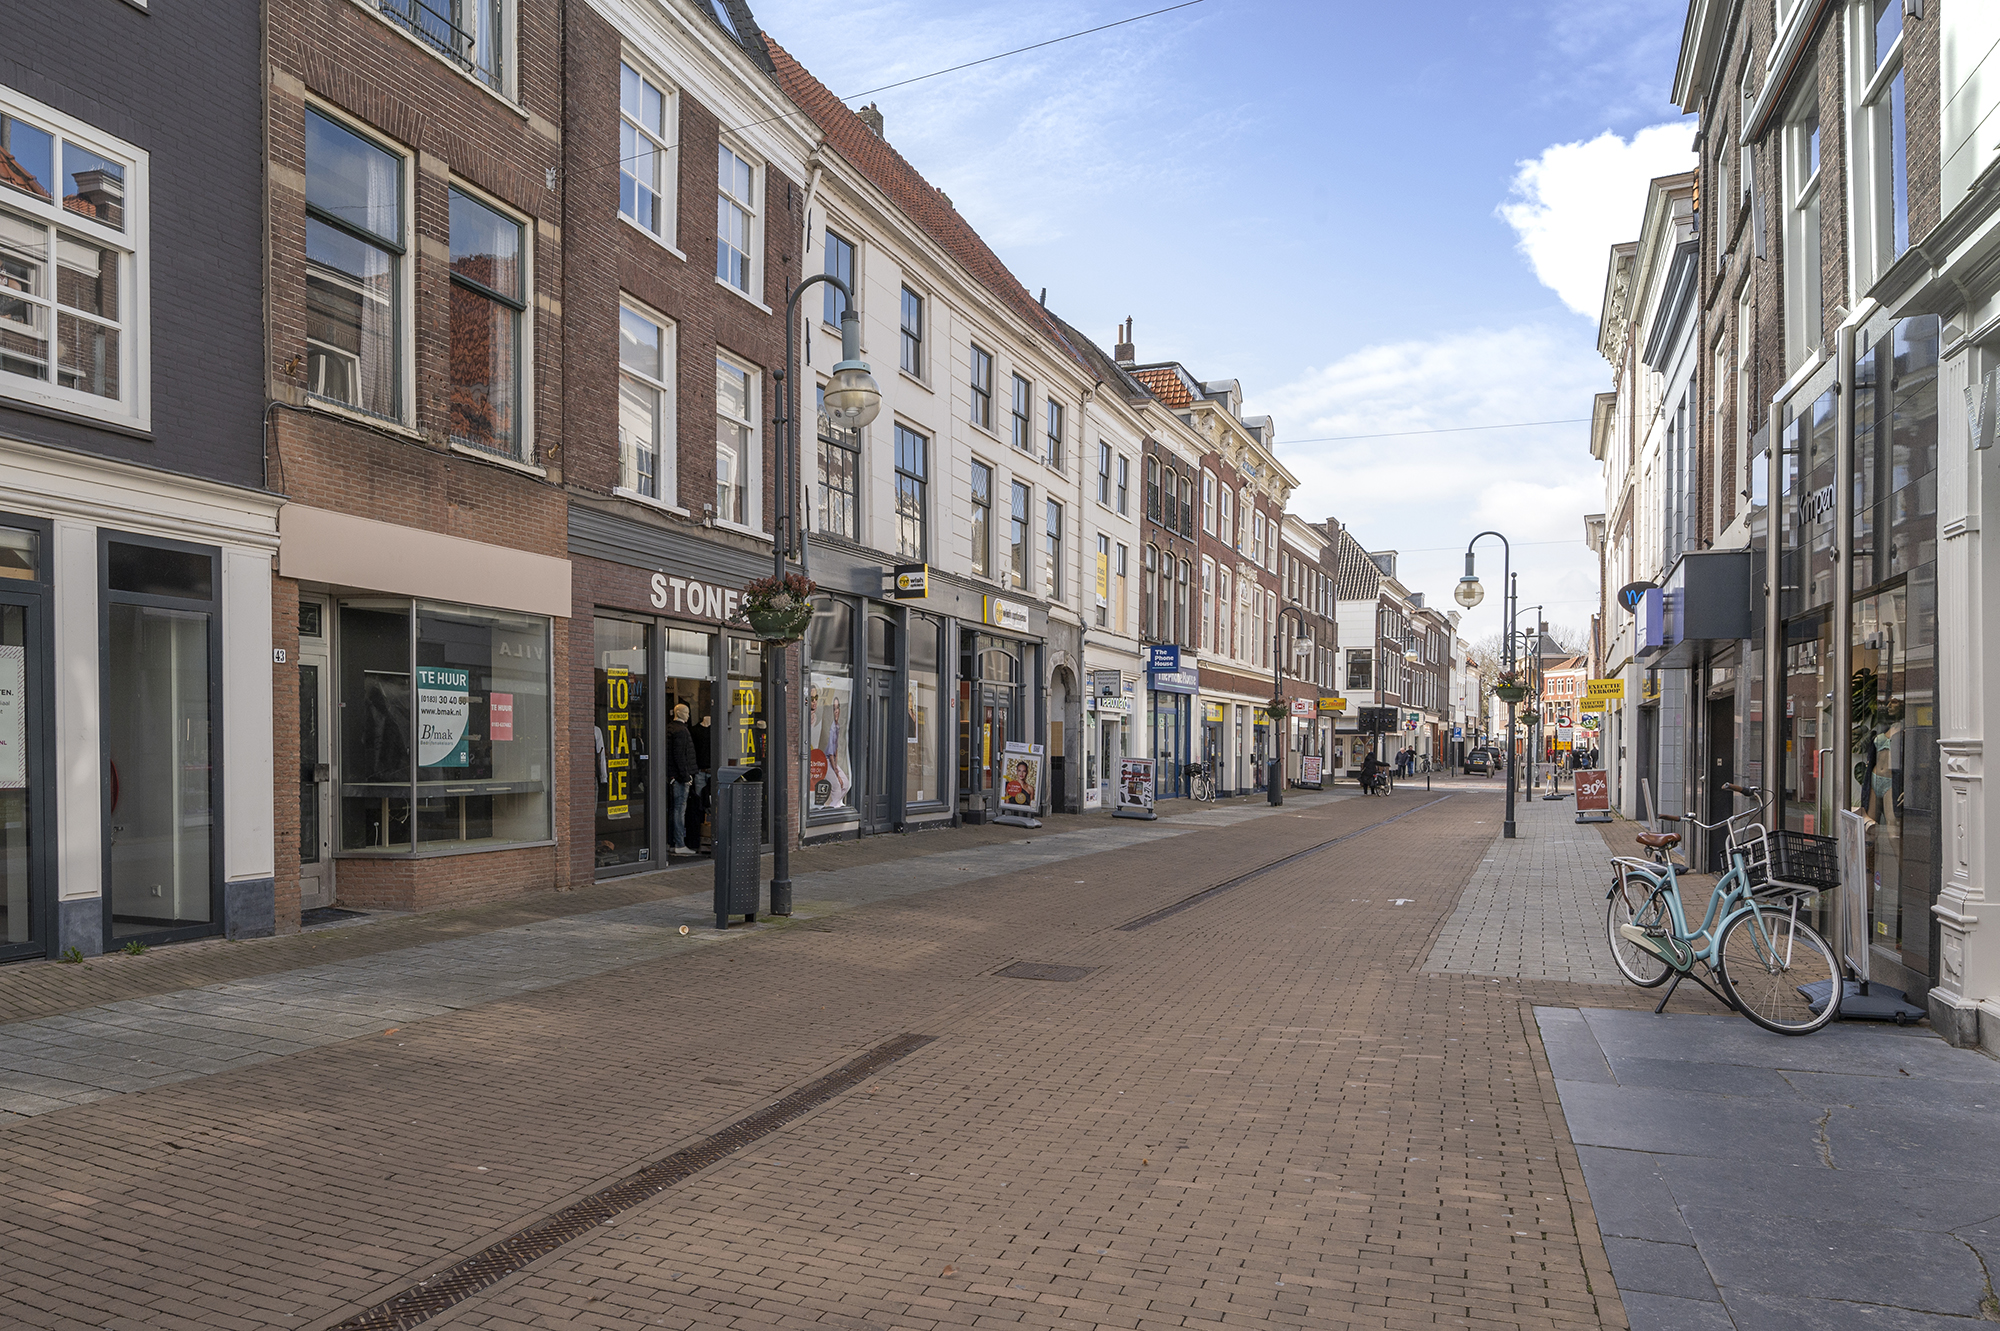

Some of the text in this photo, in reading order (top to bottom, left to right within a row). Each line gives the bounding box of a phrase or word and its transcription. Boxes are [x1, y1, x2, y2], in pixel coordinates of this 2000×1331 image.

[910, 575, 924, 583] wish
[275, 650, 285, 662] 43
[419, 671, 467, 687] TE HUUR
[438, 695, 448, 705] 30
[448, 696, 457, 705] 40
[608, 679, 629, 709] TO
[420, 708, 462, 717] www.bmak.nl
[608, 725, 629, 755] TA
[740, 729, 755, 753] TA
[608, 771, 627, 801] LE
[1577, 779, 1606, 796] -30%
